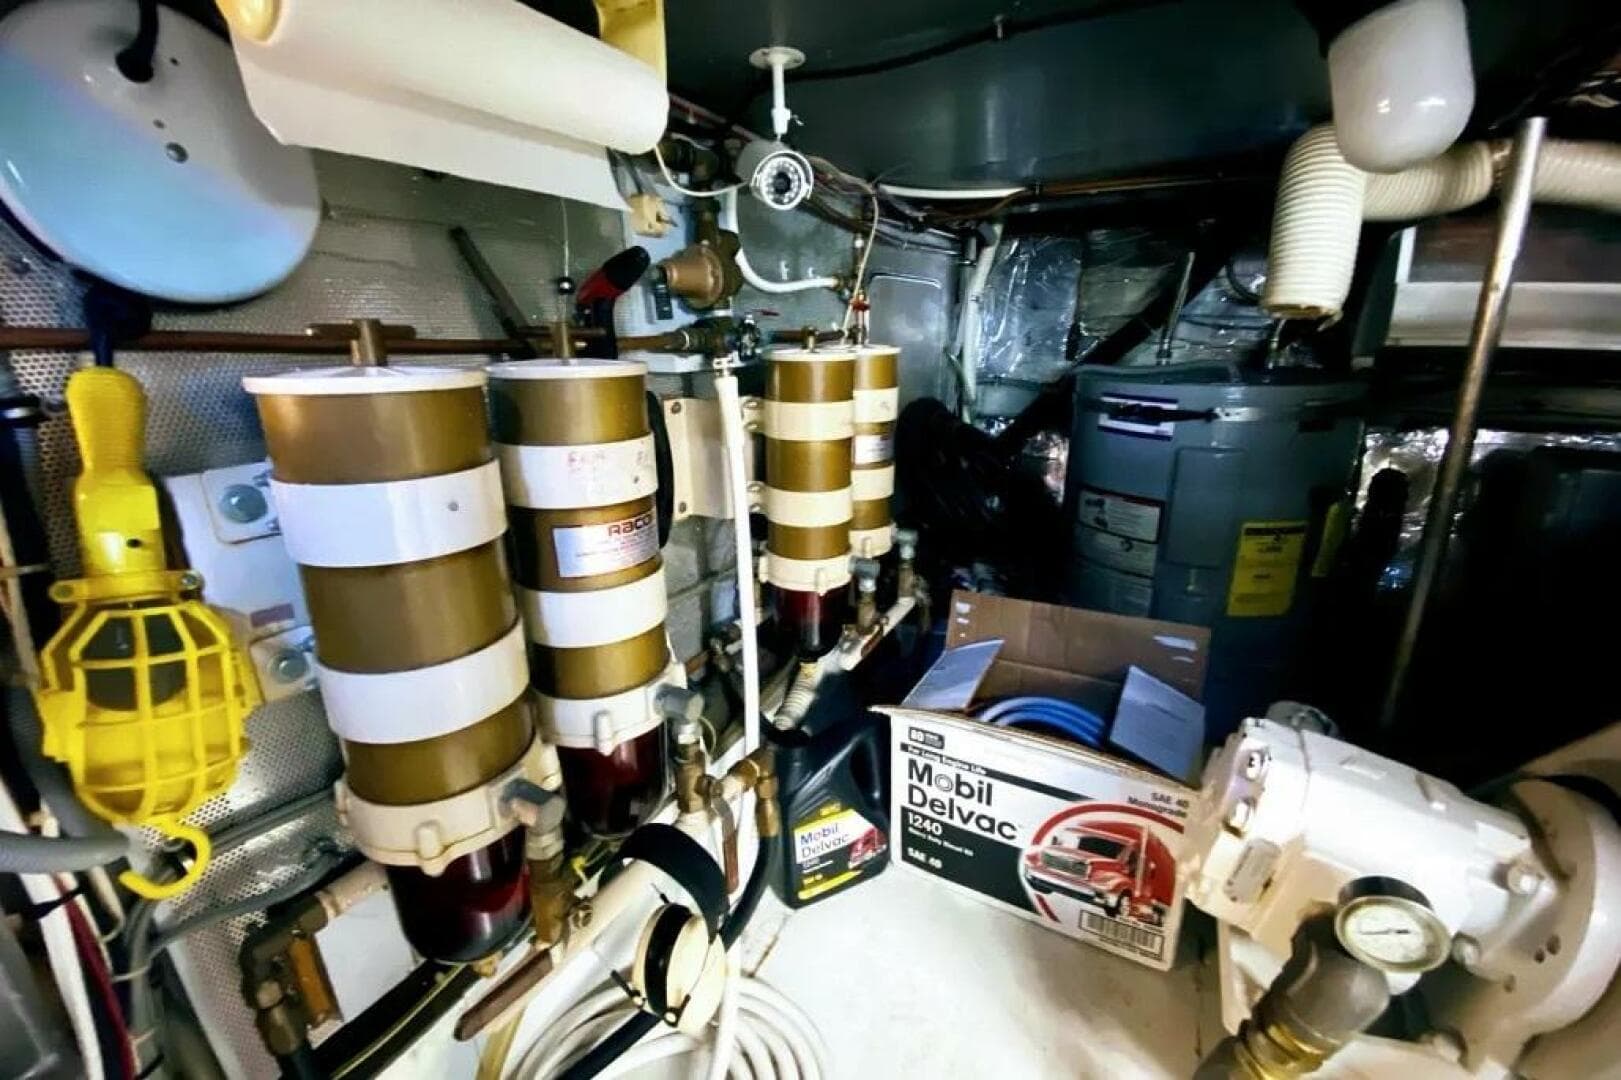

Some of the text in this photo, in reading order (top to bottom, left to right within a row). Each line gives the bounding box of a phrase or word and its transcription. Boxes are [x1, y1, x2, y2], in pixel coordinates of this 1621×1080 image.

[908, 758, 993, 807] Mobil
[908, 783, 1017, 840] Delvac
[908, 812, 942, 835] 1240
[800, 823, 838, 846] Mobil
[802, 833, 850, 859] Delvac
